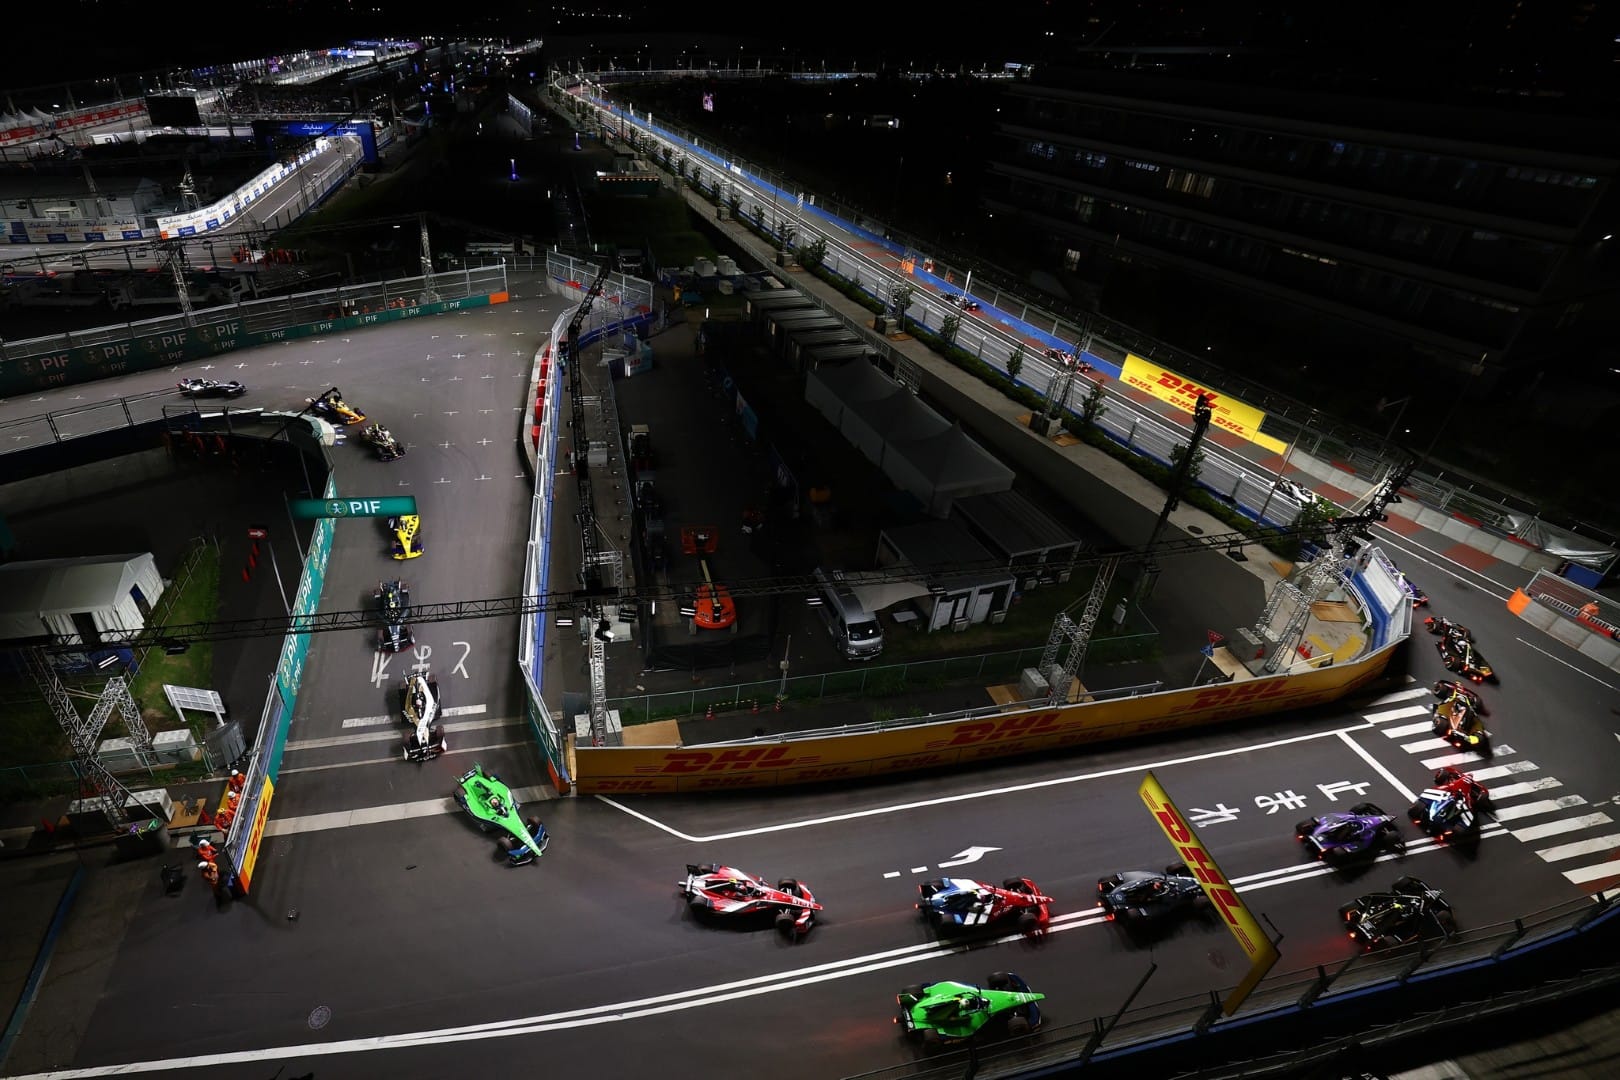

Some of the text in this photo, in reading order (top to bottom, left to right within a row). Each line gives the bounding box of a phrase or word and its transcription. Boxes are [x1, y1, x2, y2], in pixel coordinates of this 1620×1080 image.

[406, 306, 421, 315] PIF
[448, 300, 463, 309] PIF
[319, 321, 334, 331] PIF
[365, 314, 380, 324] PIF
[216, 322, 241, 338] PIF
[271, 330, 286, 340] PIF
[161, 333, 189, 349] PIF
[221, 340, 237, 350] PIF
[103, 343, 132, 359] PIF
[168, 350, 185, 361] PIF
[40, 354, 71, 371] PIF
[1128, 376, 1153, 392] DHL
[1157, 371, 1218, 409] DHL
[1215, 416, 1244, 434] DHL
[349, 500, 382, 514] PIF
[1189, 680, 1289, 710] DHL
[949, 713, 1063, 745] DHL
[660, 747, 797, 774] DHL
[597, 779, 657, 791] DHL
[701, 775, 756, 788] DHL
[1189, 781, 1371, 828] 止まれ
[250, 798, 269, 856] DHL
[1156, 803, 1241, 925] DHL
